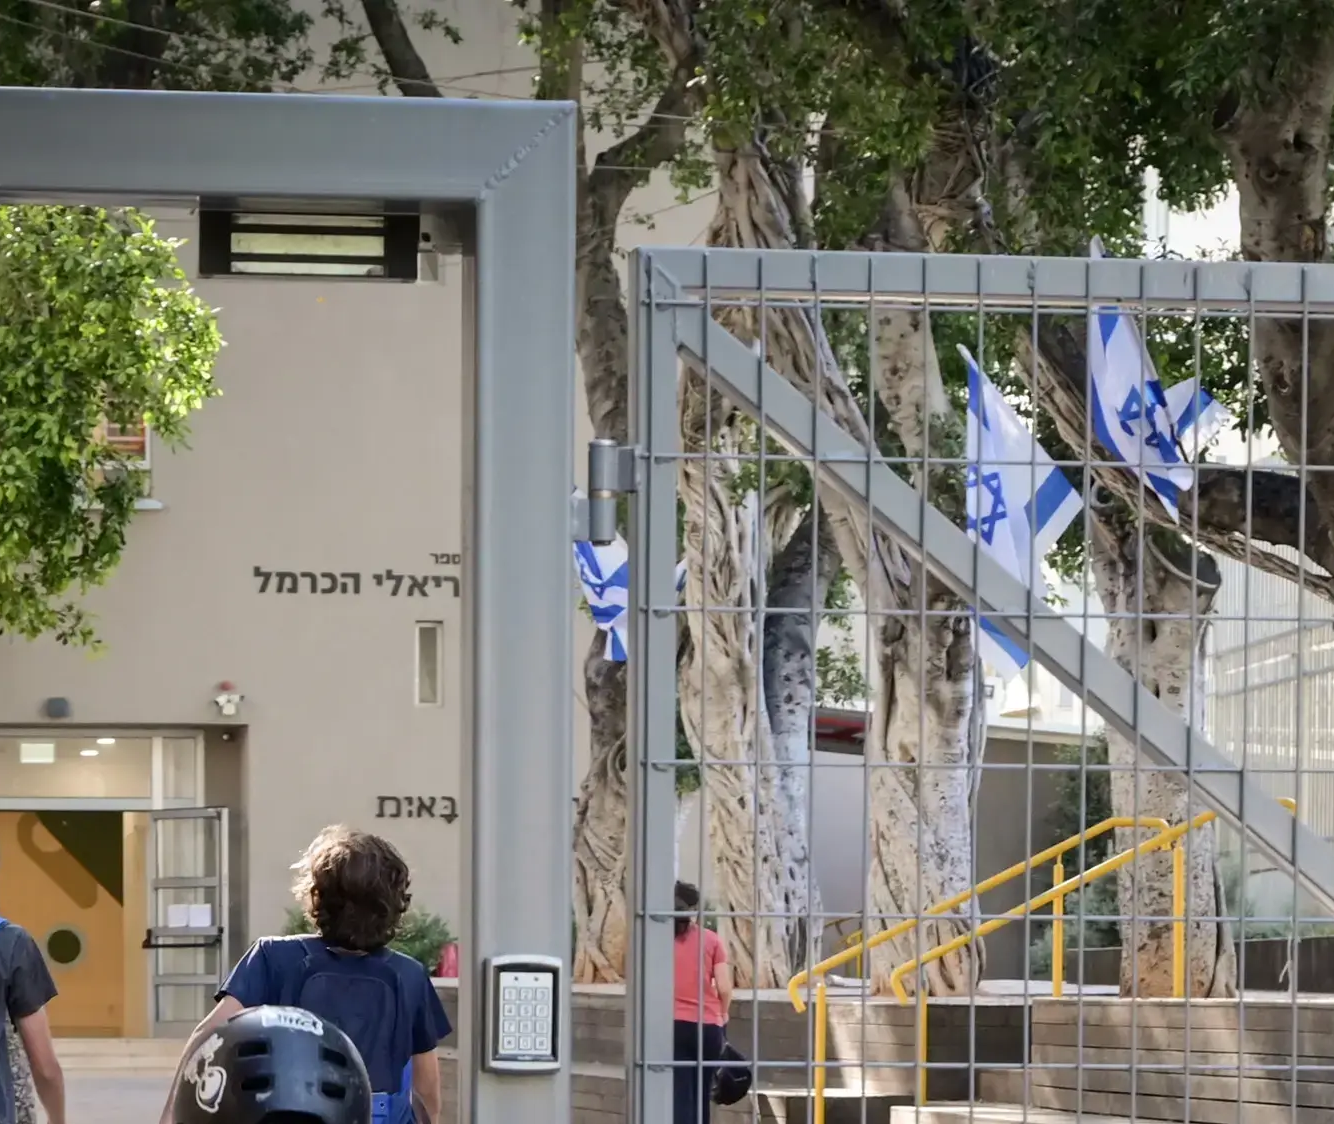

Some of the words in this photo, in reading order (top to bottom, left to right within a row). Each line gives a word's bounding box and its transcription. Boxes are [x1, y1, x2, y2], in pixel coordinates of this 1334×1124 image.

[429, 553, 461, 565] ספר
[253, 566, 361, 594] הכרמל
[372, 569, 461, 598] ריאלי
